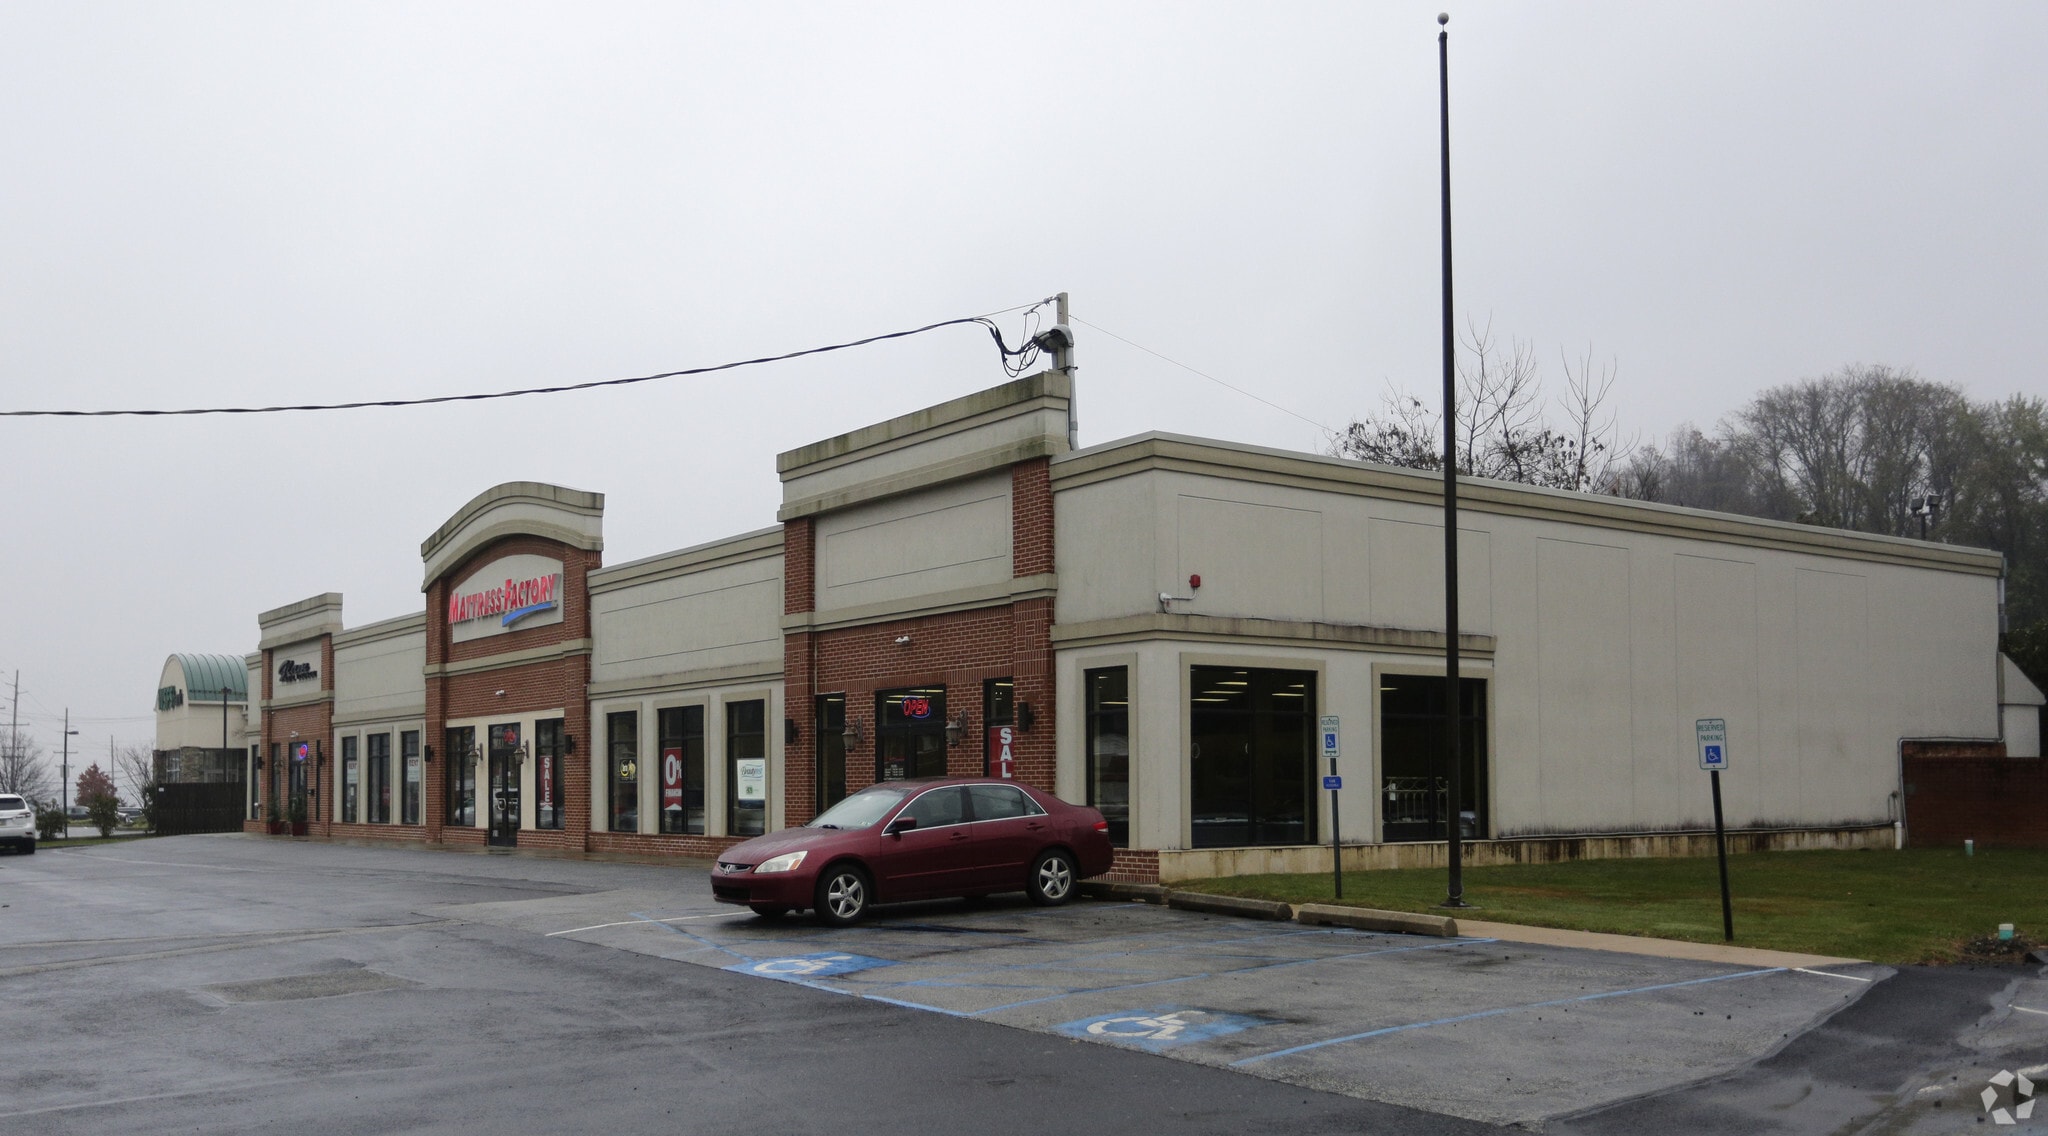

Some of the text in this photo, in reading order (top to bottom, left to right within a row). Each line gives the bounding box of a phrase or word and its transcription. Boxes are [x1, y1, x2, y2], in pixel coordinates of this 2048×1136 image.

[448, 573, 559, 625] MATTRESS FACTORY
[903, 699, 929, 716] OPEN
[1697, 724, 1724, 732] RESERVED
[1700, 734, 1723, 742] PARKING
[999, 727, 1013, 778] SAL
[665, 754, 682, 785] 0%
